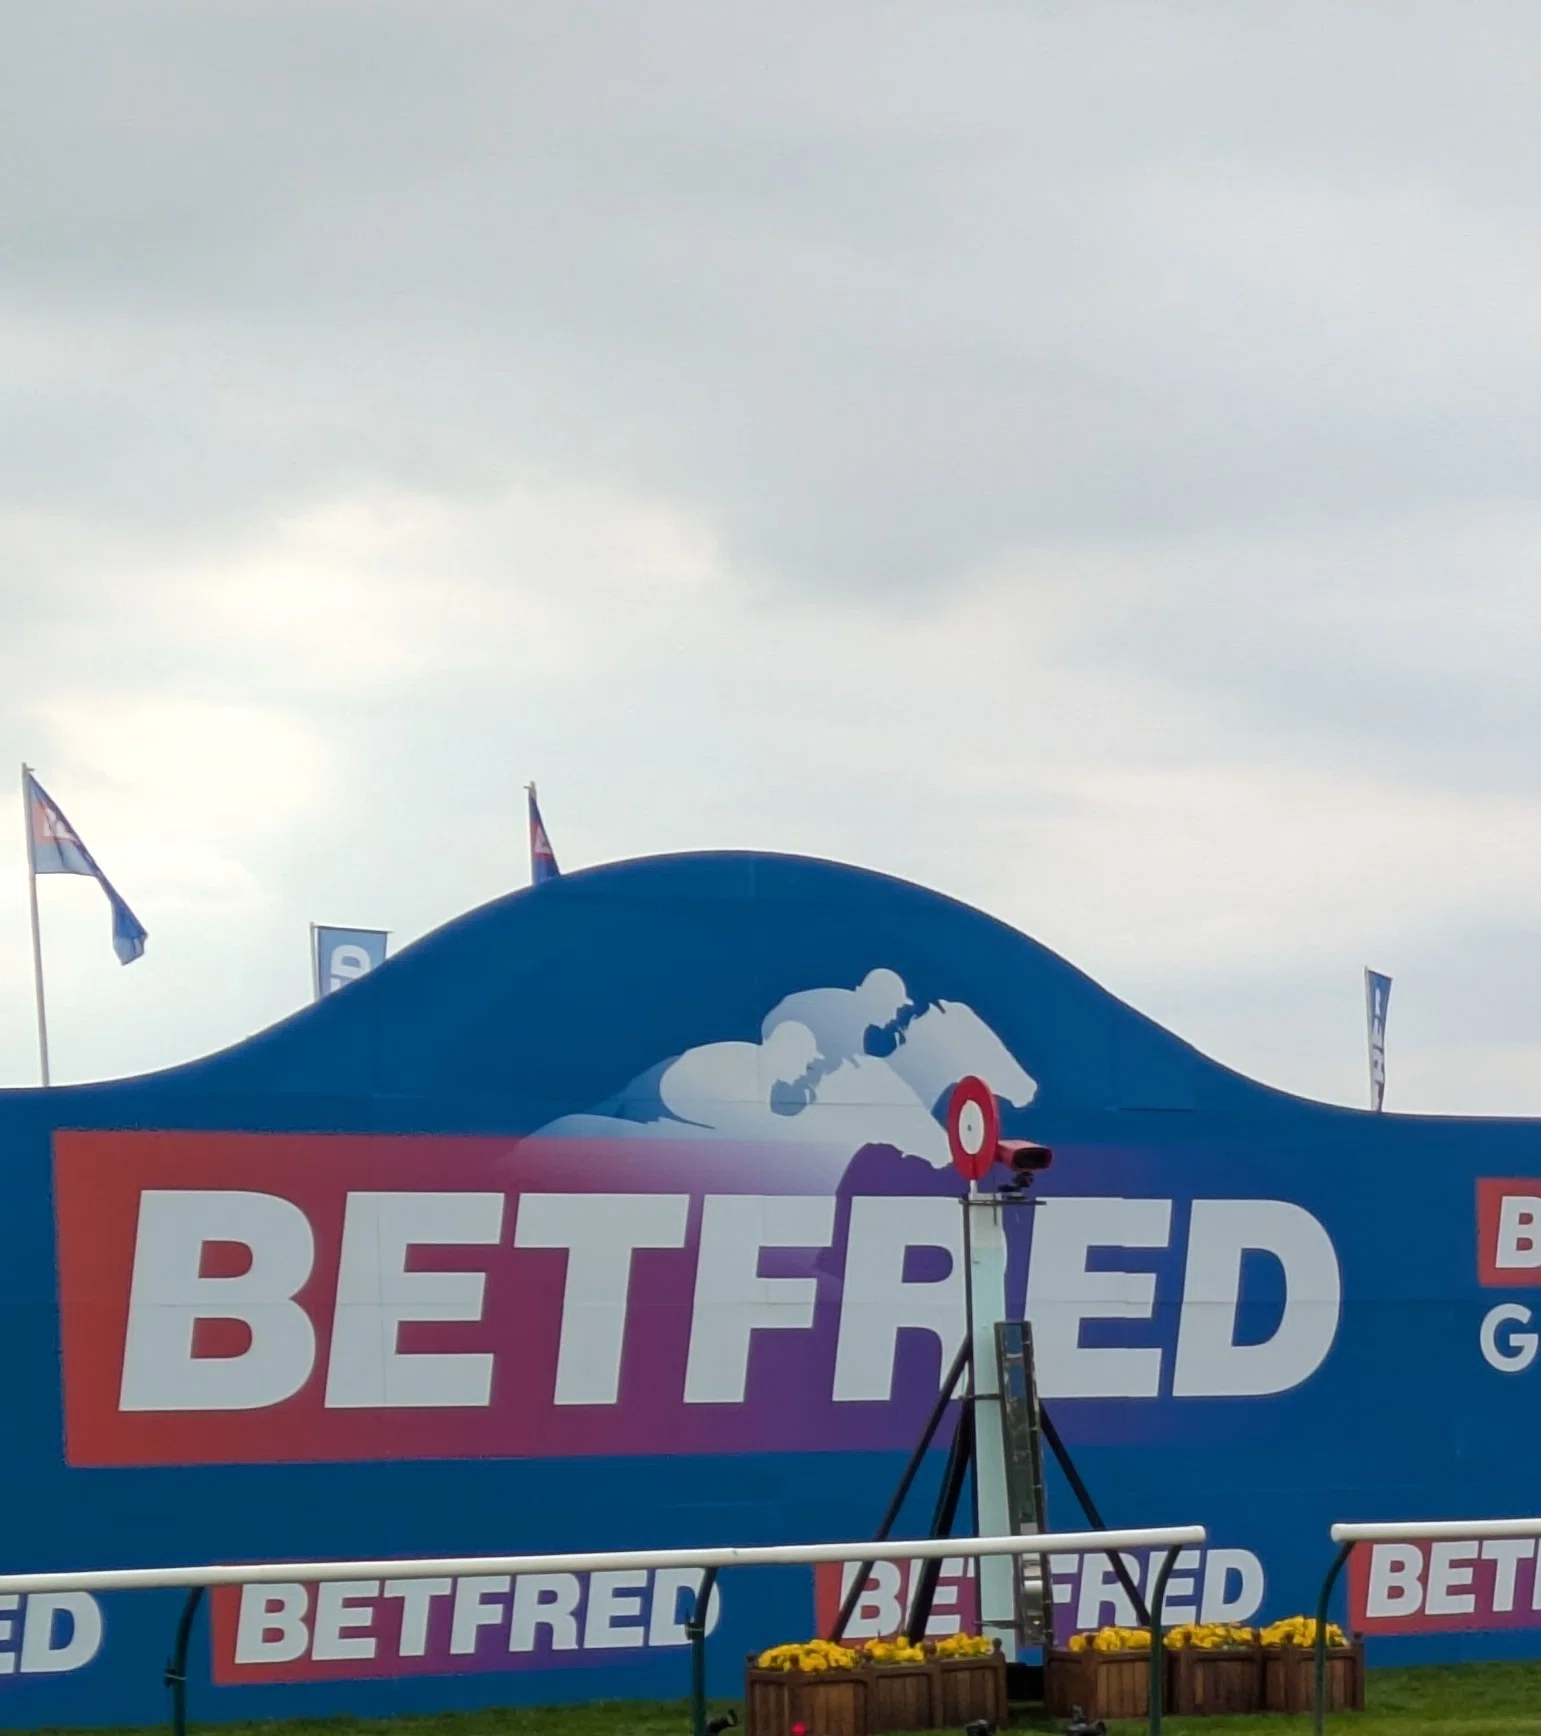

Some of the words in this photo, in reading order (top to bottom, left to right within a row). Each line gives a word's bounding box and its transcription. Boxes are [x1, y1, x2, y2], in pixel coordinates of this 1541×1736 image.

[118, 1189, 1341, 1412] BETFRED
[234, 1567, 721, 1665] BETFRED
[840, 1548, 1265, 1639] BEFRED
